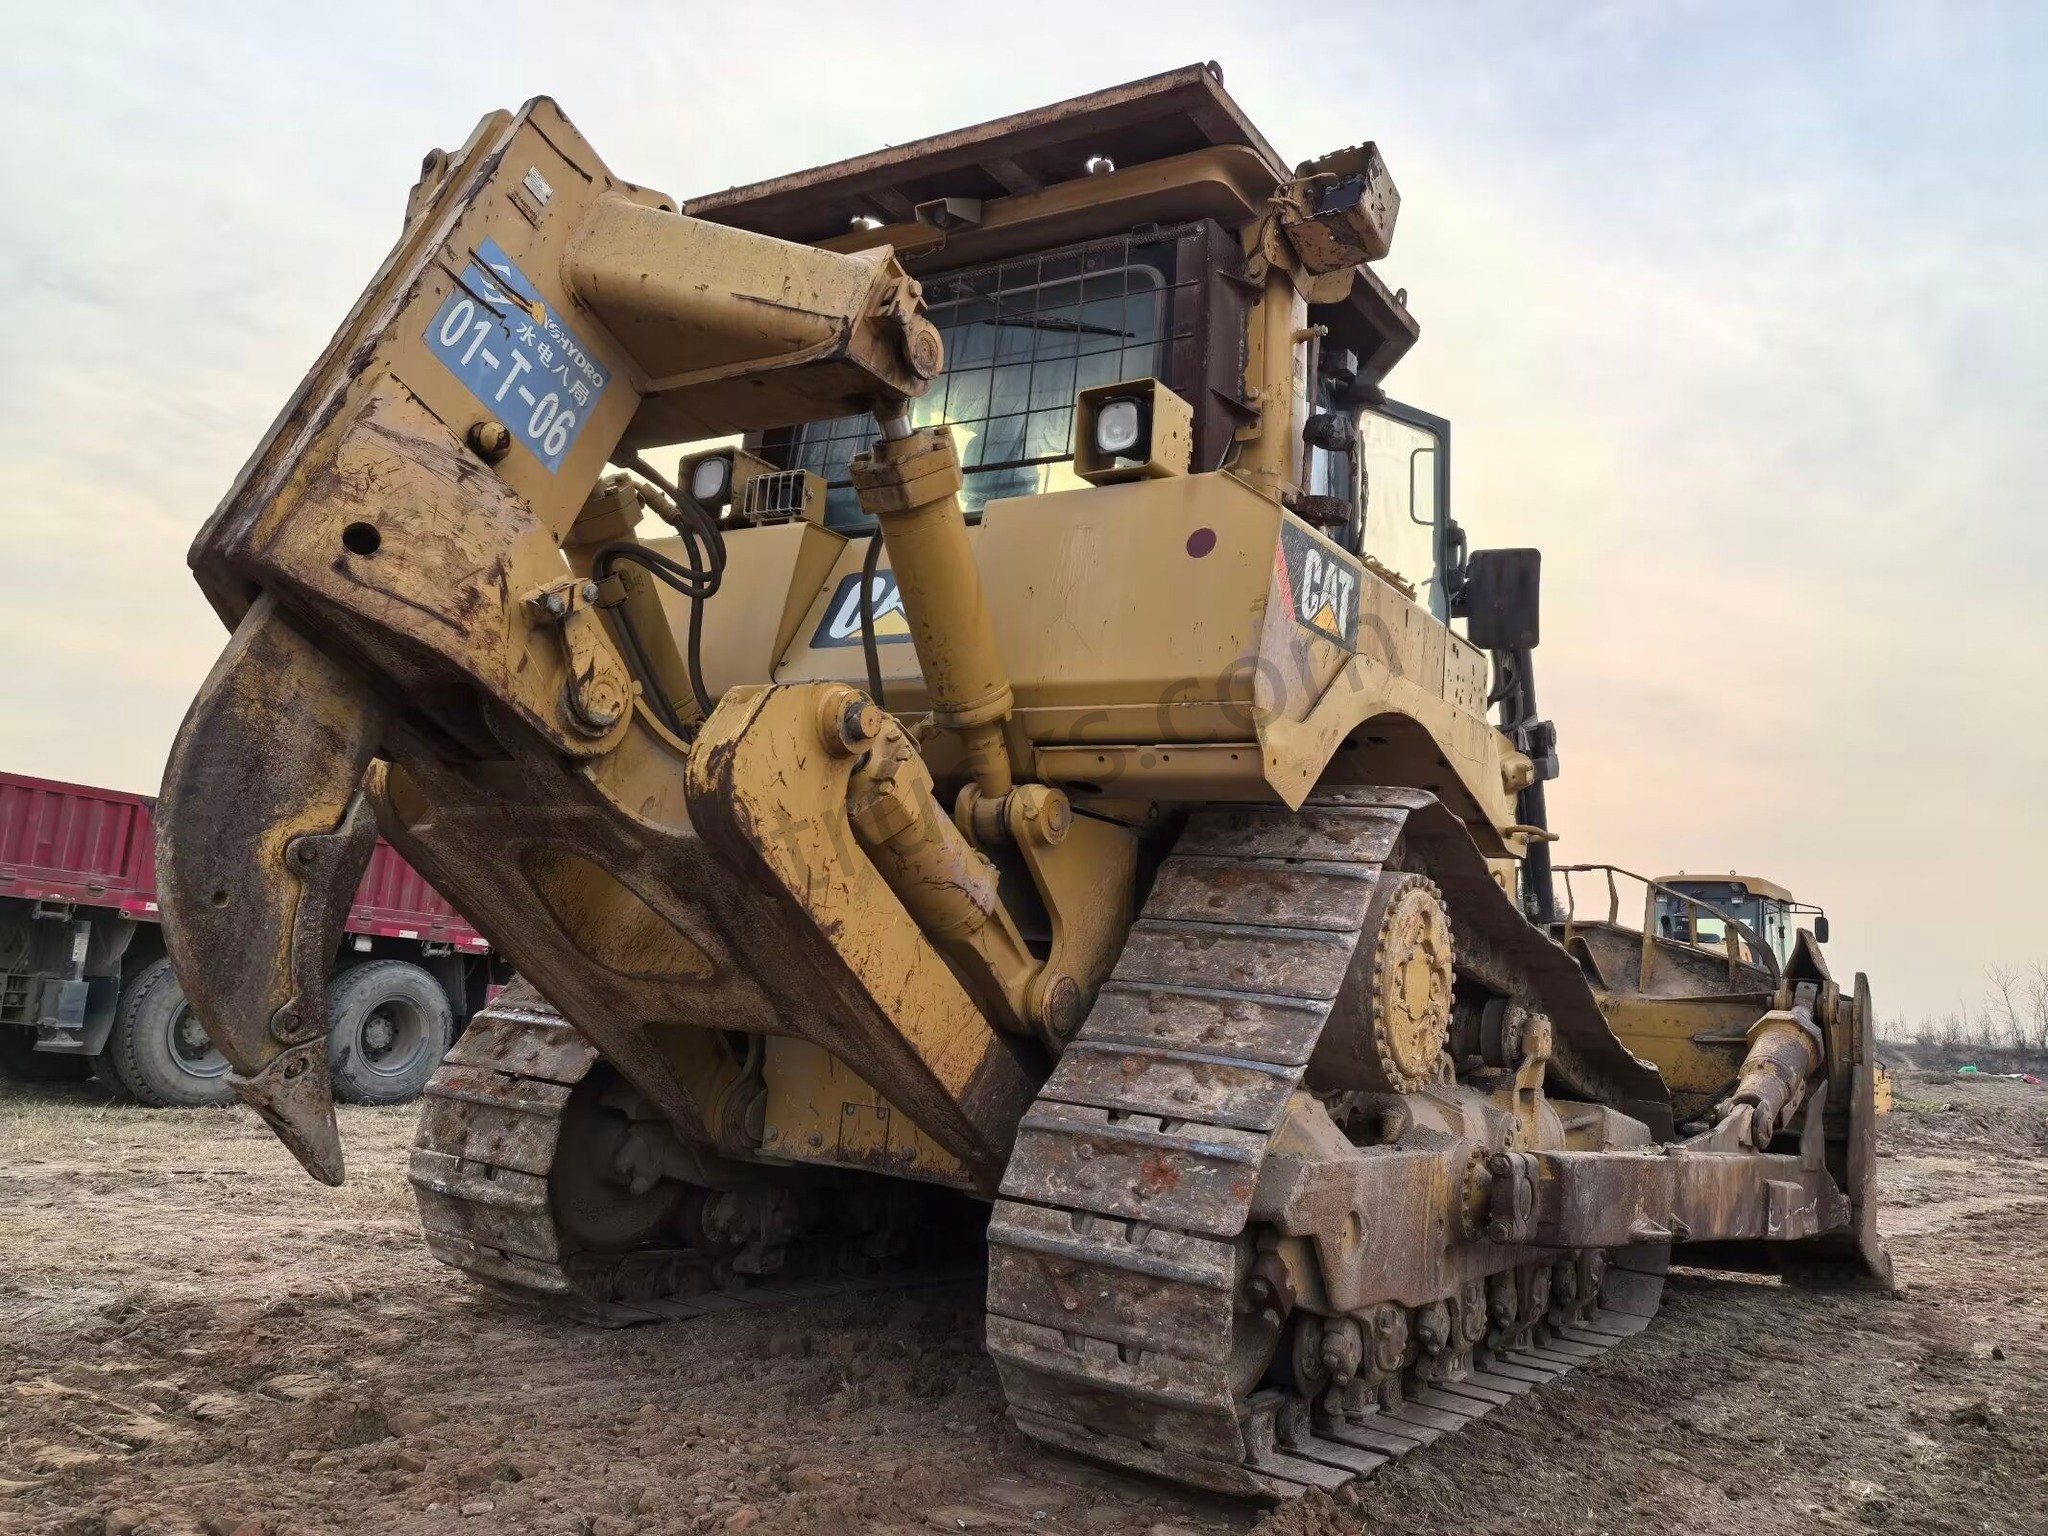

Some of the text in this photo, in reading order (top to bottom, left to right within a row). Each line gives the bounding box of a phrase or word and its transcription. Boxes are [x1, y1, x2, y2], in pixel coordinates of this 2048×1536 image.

[440, 299, 576, 457] 01-T-06
[516, 321, 590, 407] 水电八局
[1301, 548, 1355, 642] CAT
